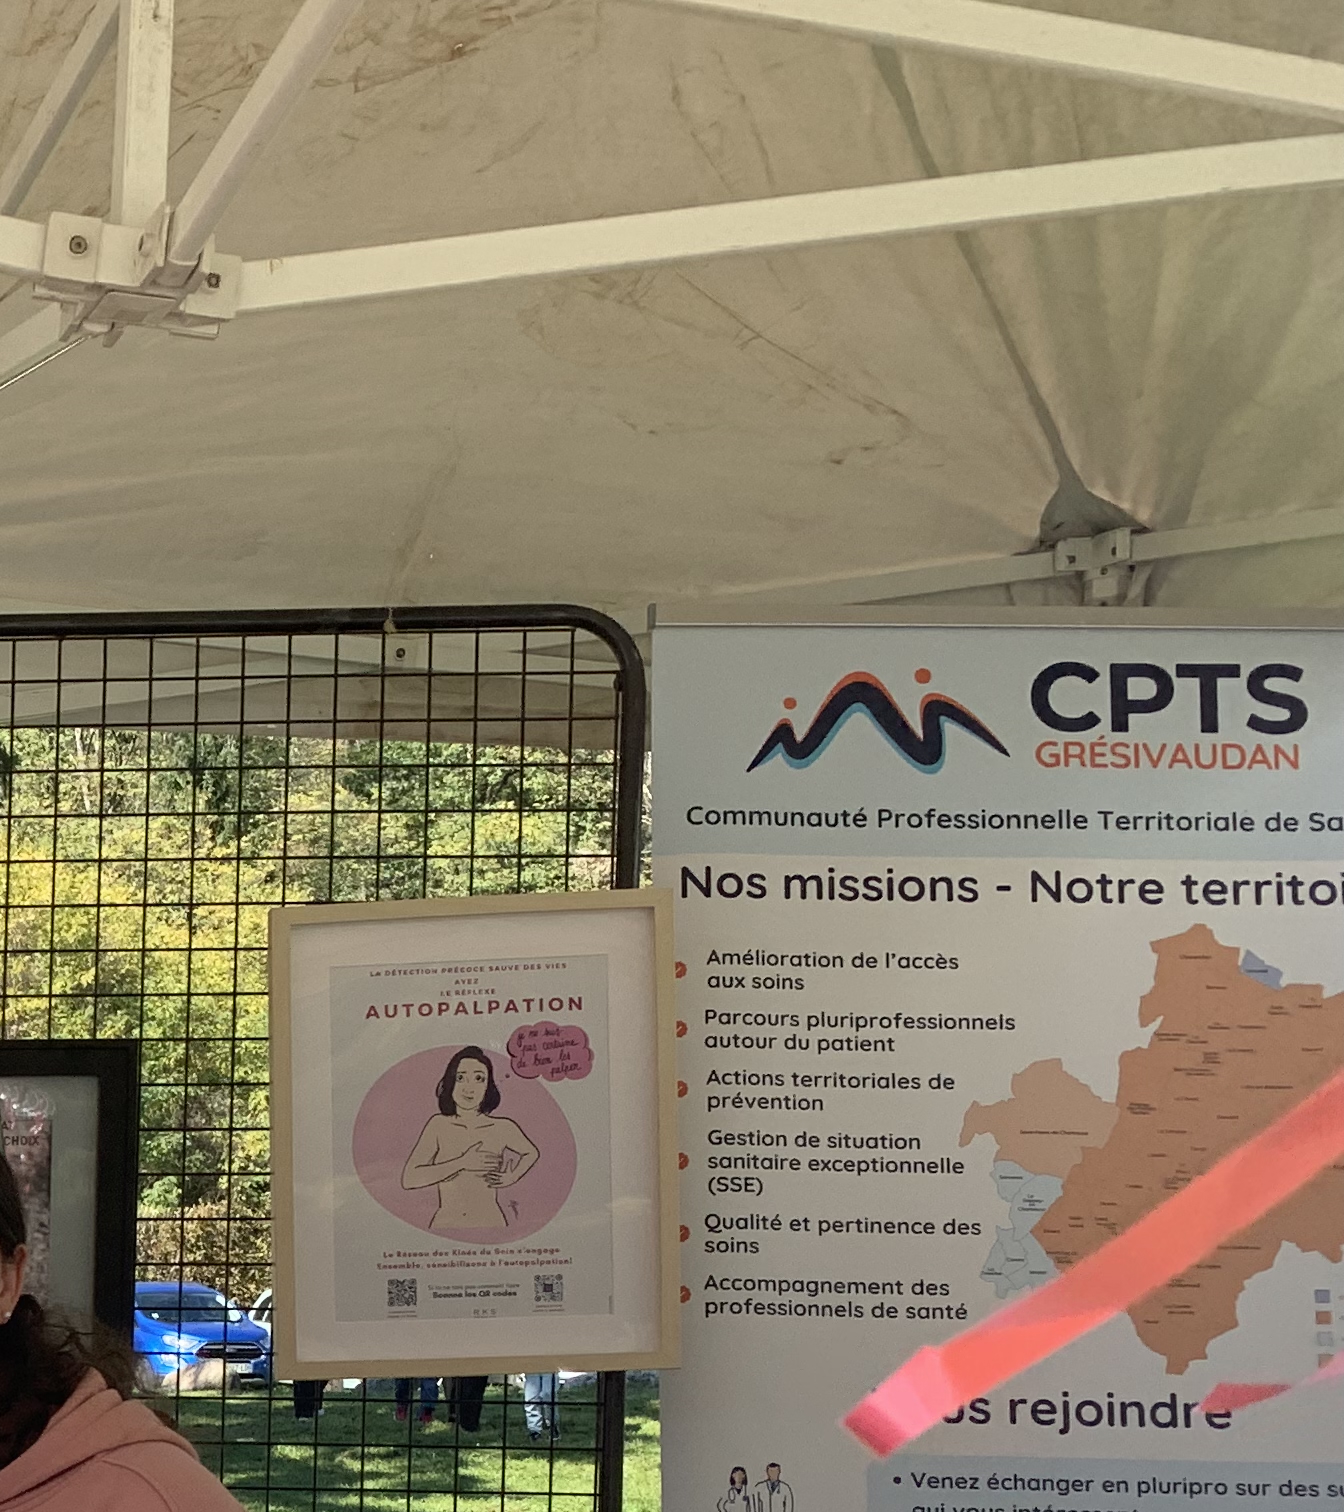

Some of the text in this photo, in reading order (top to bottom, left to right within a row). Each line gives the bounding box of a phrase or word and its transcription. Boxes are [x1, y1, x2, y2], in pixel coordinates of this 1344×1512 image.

[1030, 661, 1308, 735] CPTS
[1034, 736, 1300, 772] GRÉSIVAUDAN
[686, 805, 1344, 833] Communauté Professionnelle Territoriale de Sa
[680, 865, 1344, 906] Nos missions Notre territoi
[384, 968, 438, 977] DÉTECTION
[440, 965, 485, 974] PRÉCOCE
[488, 964, 520, 972] SAUVE
[522, 963, 542, 971] DES
[544, 962, 567, 970] VIES
[706, 948, 959, 970] Amélioration de l'accès
[454, 978, 479, 986] AYEZ
[707, 975, 805, 991] aux soins
[365, 996, 583, 1020] AUTOPALPATION
[704, 1008, 1016, 1033] Parcours pluriprofessionnels
[703, 1033, 895, 1055] autour du patient
[705, 1069, 955, 1091] Actions territoriales de
[707, 1091, 824, 1113] prévention
[707, 1129, 921, 1150] Gestion de situation
[707, 1153, 965, 1177] sanitaire exceptionnelle
[707, 1176, 764, 1197] (SSE)
[704, 1213, 982, 1237] Qualité et pertinence des
[704, 1236, 760, 1254] soins
[703, 1274, 952, 1298] Accompagnement des
[704, 1297, 968, 1321] professionnels de santé
